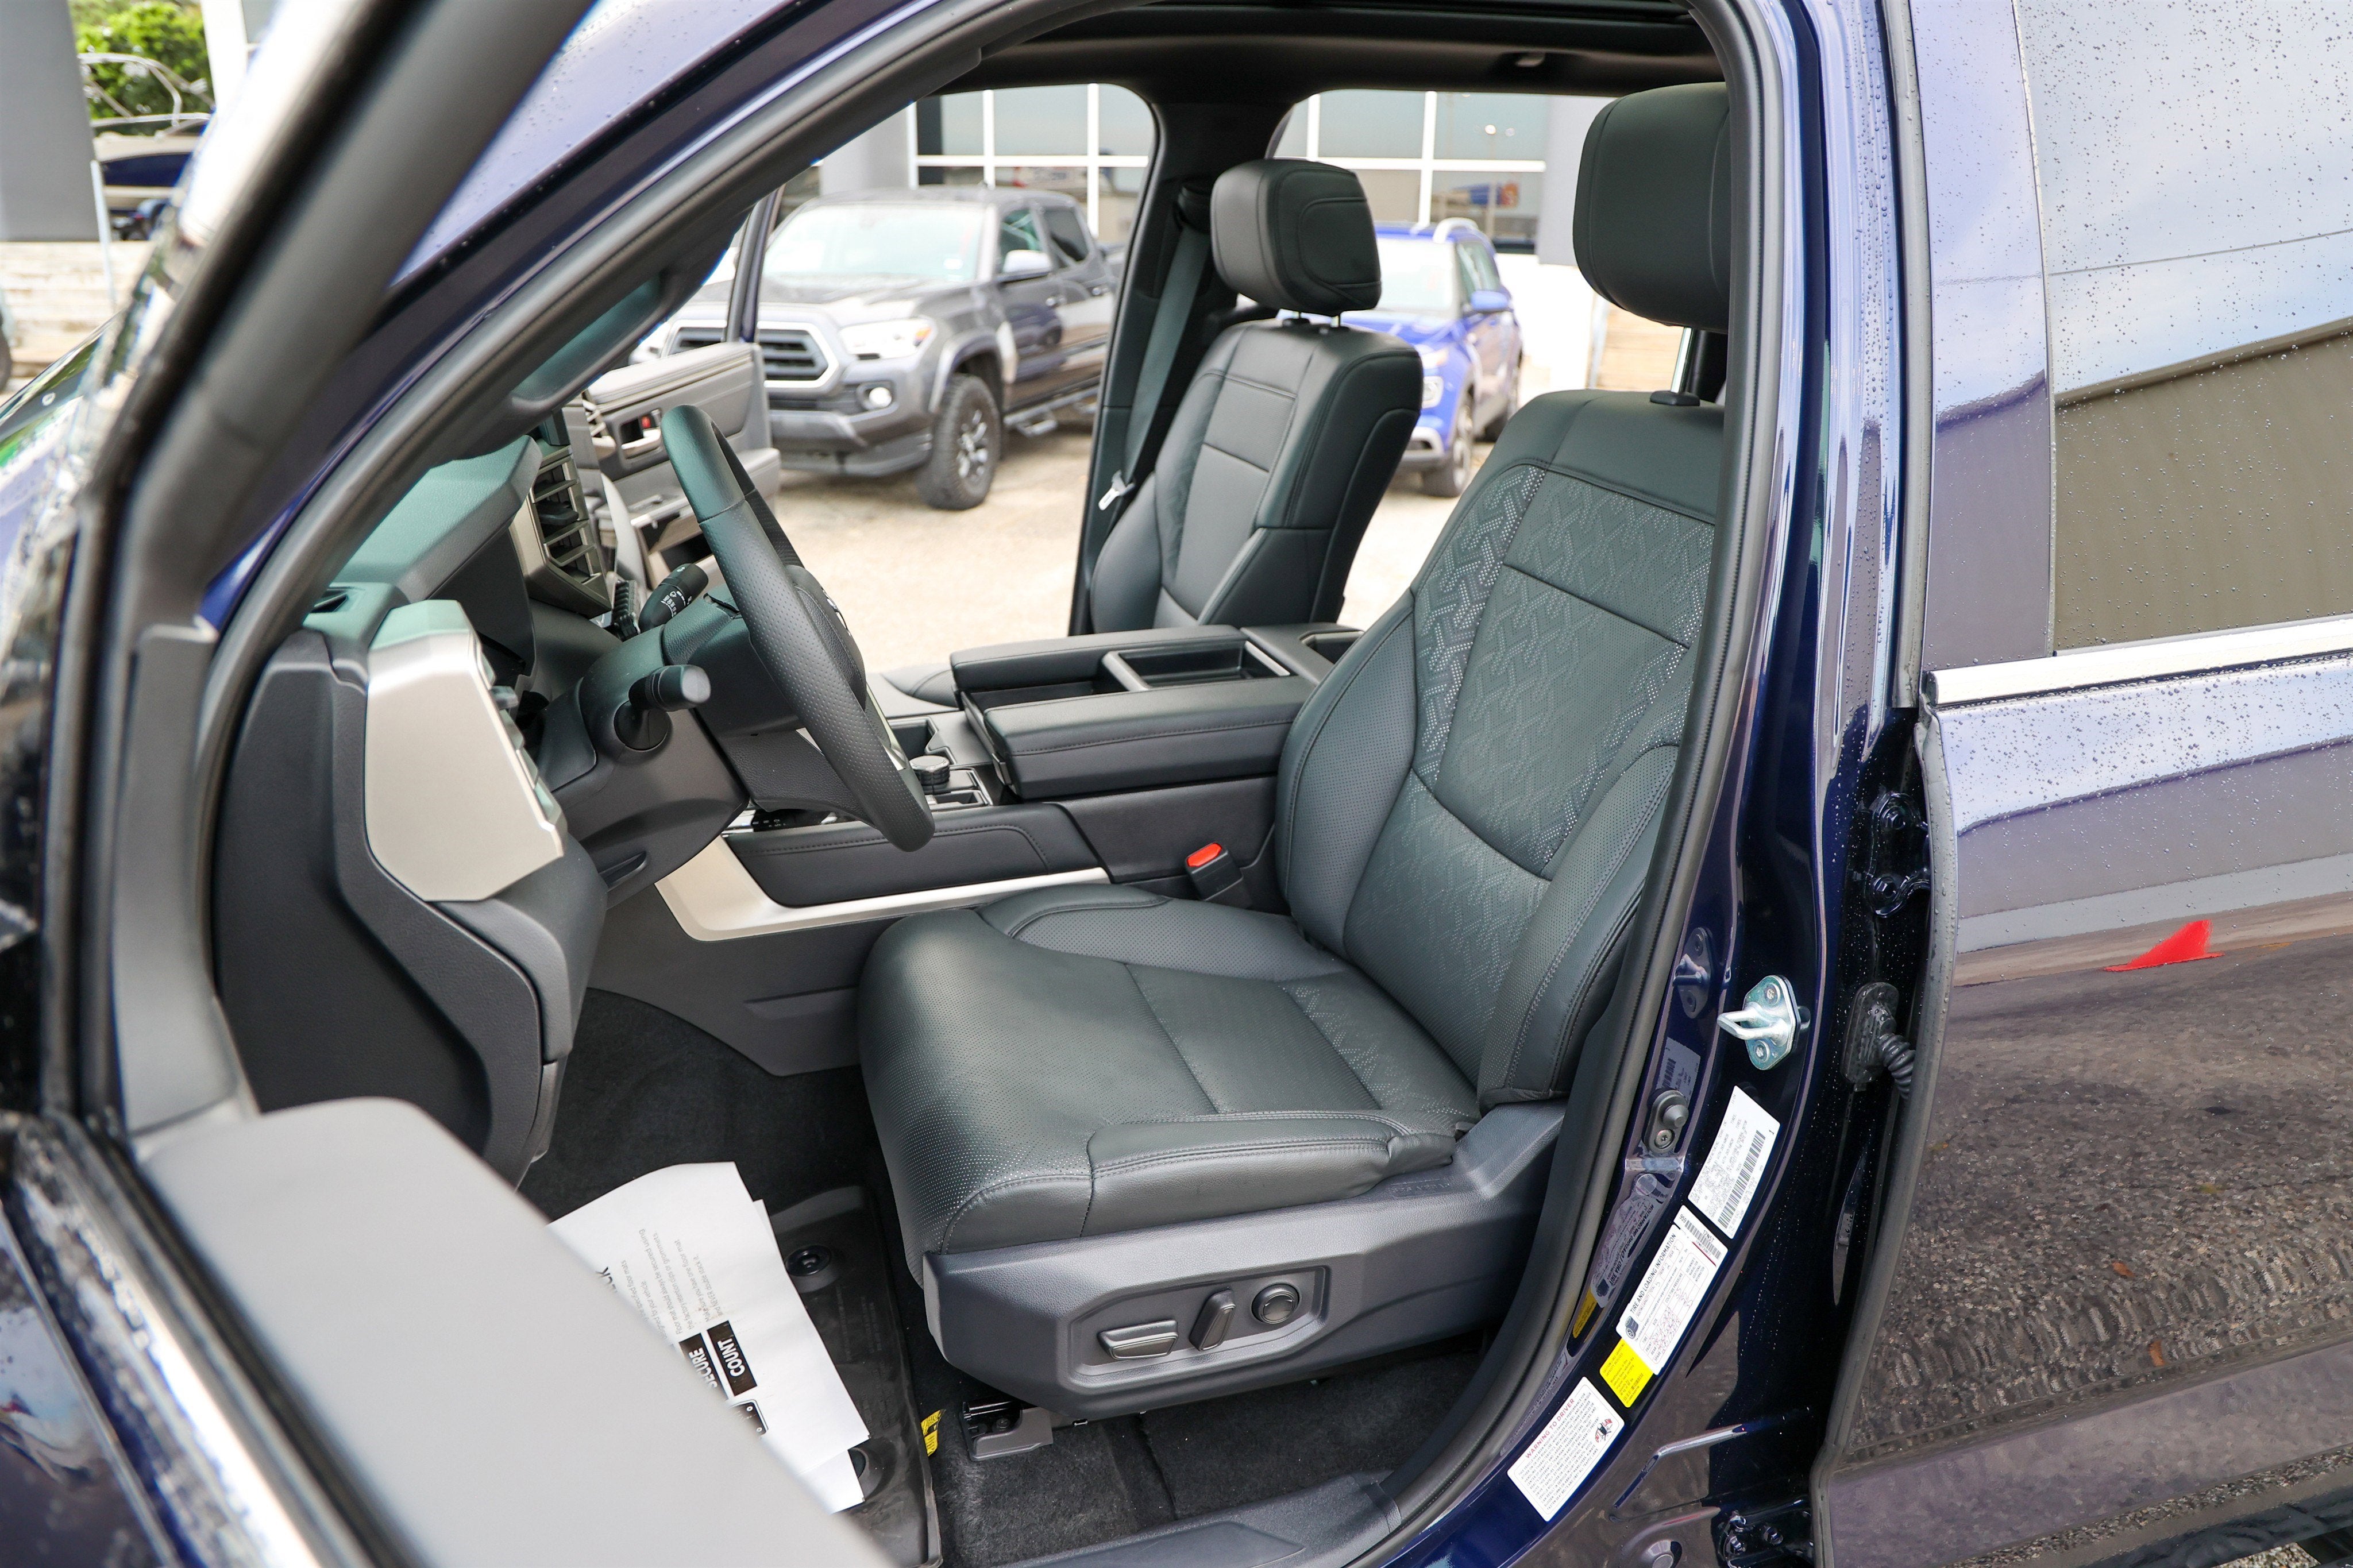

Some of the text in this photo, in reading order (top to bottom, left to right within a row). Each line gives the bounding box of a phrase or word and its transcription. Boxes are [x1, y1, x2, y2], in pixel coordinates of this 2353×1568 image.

[653, 1233, 670, 1265] grommets.
[674, 1239, 683, 1252] mat
[621, 1260, 630, 1275] mats
[680, 1253, 689, 1268] floor
[695, 1261, 705, 1275] stack
[668, 1271, 676, 1283] clips
[1630, 1234, 1676, 1314] TIRE AND LOADING INFORMATION
[1673, 1273, 1683, 1288] PRESSURE
[639, 1229, 683, 1335] Floor mat should always be secured using
[689, 1278, 698, 1289] have
[701, 1275, 712, 1291] double
[630, 1287, 643, 1310] specified
[672, 1283, 684, 1303] retention
[695, 1288, 704, 1298] you
[708, 1291, 718, 1307] NEVER
[647, 1299, 657, 1310] your
[698, 1297, 707, 1308] sure
[680, 1303, 691, 1321] factory
[703, 1308, 712, 1322] Make
[714, 1306, 723, 1318] and
[718, 1338, 745, 1376] COUNT
[1526, 1399, 1575, 1458] WARNING TO DRIVER
